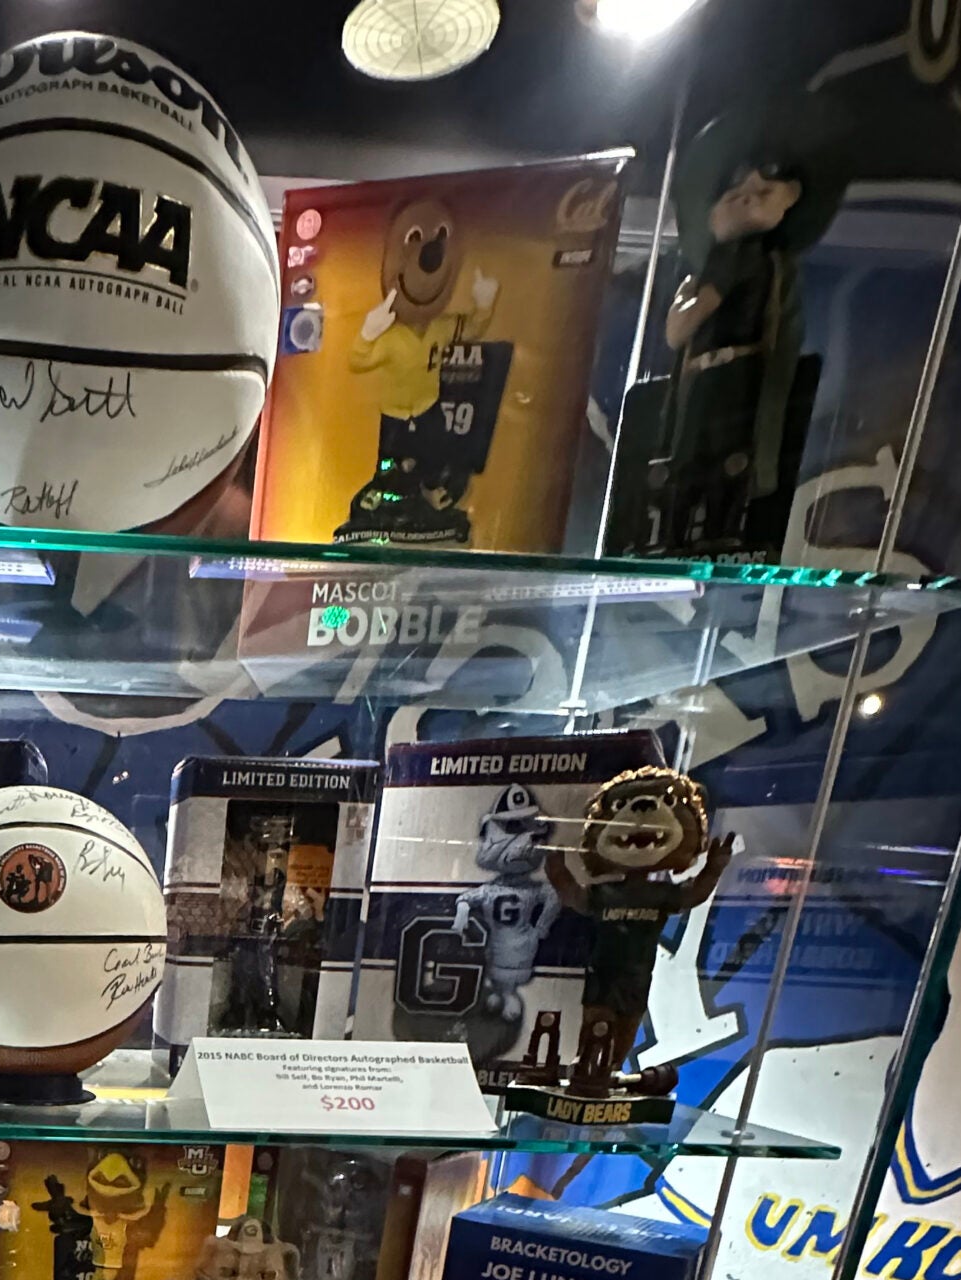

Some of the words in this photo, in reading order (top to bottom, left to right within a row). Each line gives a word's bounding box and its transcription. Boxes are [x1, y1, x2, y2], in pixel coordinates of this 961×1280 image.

[98, 81, 195, 131] BASKETBALL
[26, 273, 61, 288] NCAA
[69, 276, 149, 304] AUTOGRAPH
[155, 295, 185, 317] BALL
[312, 581, 401, 604] MASCOT
[307, 605, 488, 648] BOBBLE
[430, 755, 505, 776] LIMITED
[509, 752, 588, 774] EDITION
[222, 771, 286, 787] LIMITED
[289, 774, 351, 790] EDITION
[492, 894, 521, 926] G
[394, 915, 489, 1017] G
[197, 1051, 222, 1060] 2015
[225, 1052, 254, 1061] NABC
[256, 1052, 287, 1062] Board
[290, 1052, 299, 1062] of
[302, 1053, 348, 1063] Directors
[351, 1054, 416, 1066] Autographed
[418, 1054, 469, 1065] Basketball
[320, 1094, 376, 1112] $200
[546, 1097, 582, 1123] LADY
[582, 1101, 632, 1124] BEARS
[490, 1235, 633, 1277] BRACKETOLOGY
